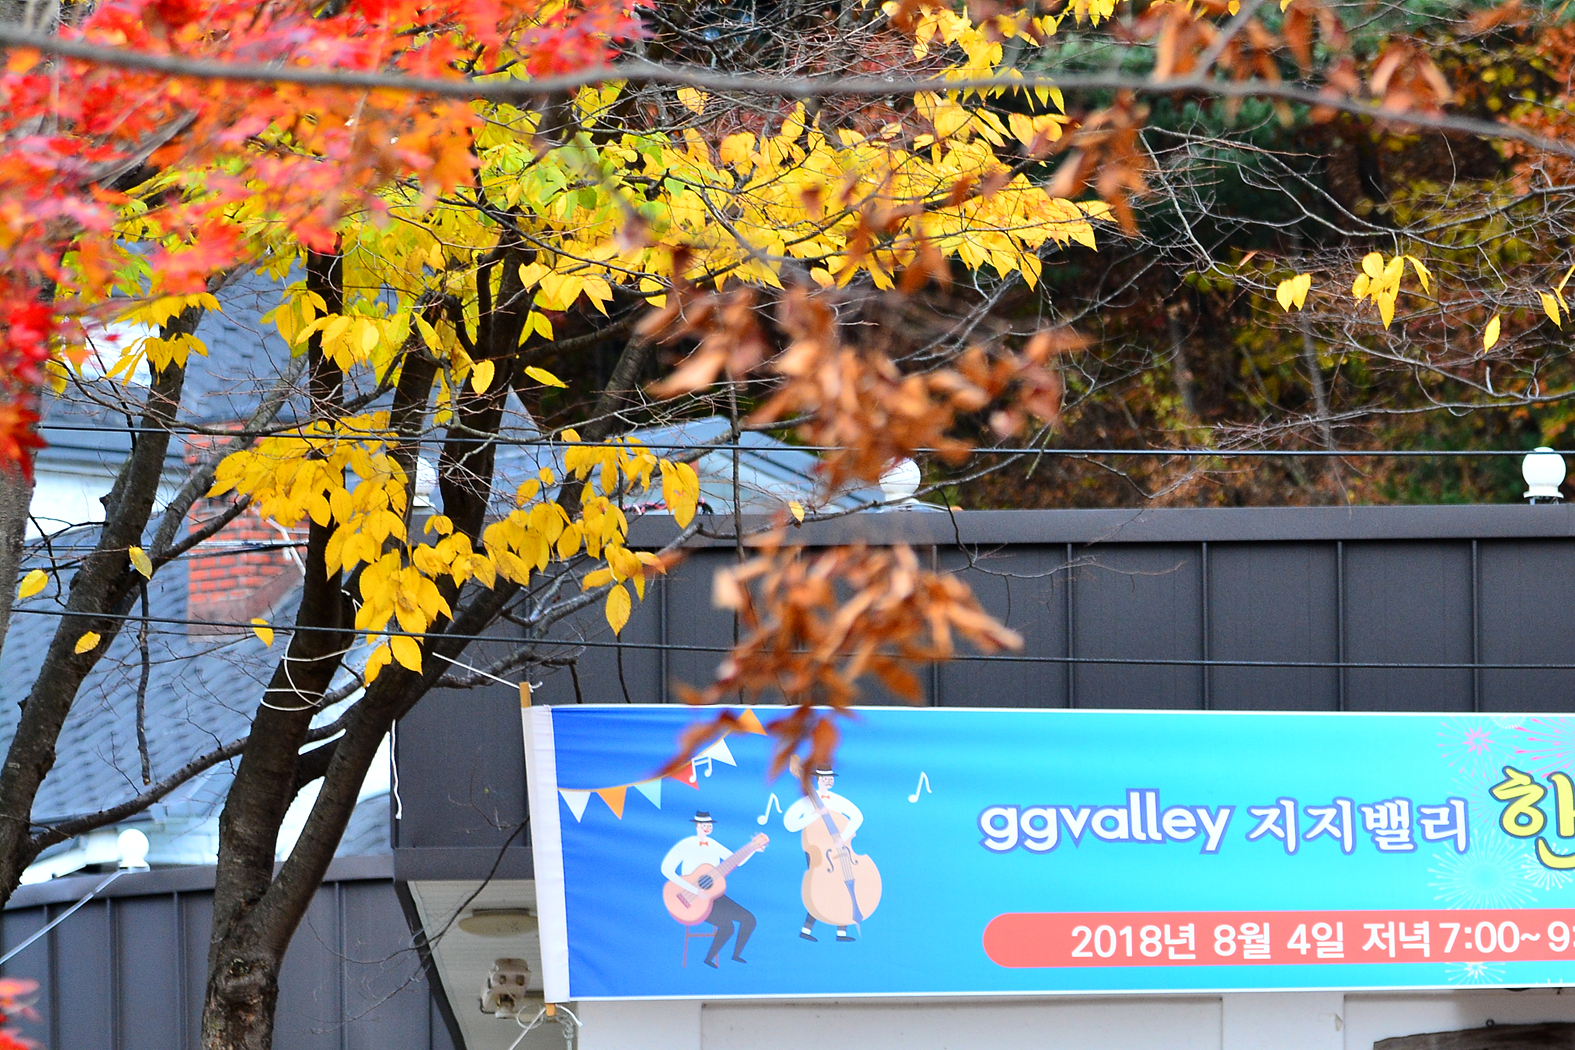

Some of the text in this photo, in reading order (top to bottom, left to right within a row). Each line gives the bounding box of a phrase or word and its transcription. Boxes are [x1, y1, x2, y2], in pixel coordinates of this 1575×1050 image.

[980, 790, 1233, 852] ggvalley
[1249, 798, 1468, 853] 지지밸리
[1071, 922, 1197, 960] 2018년
[1213, 922, 1272, 960] 8월
[1286, 921, 1345, 959] 4일
[1362, 920, 1431, 958] 저녁
